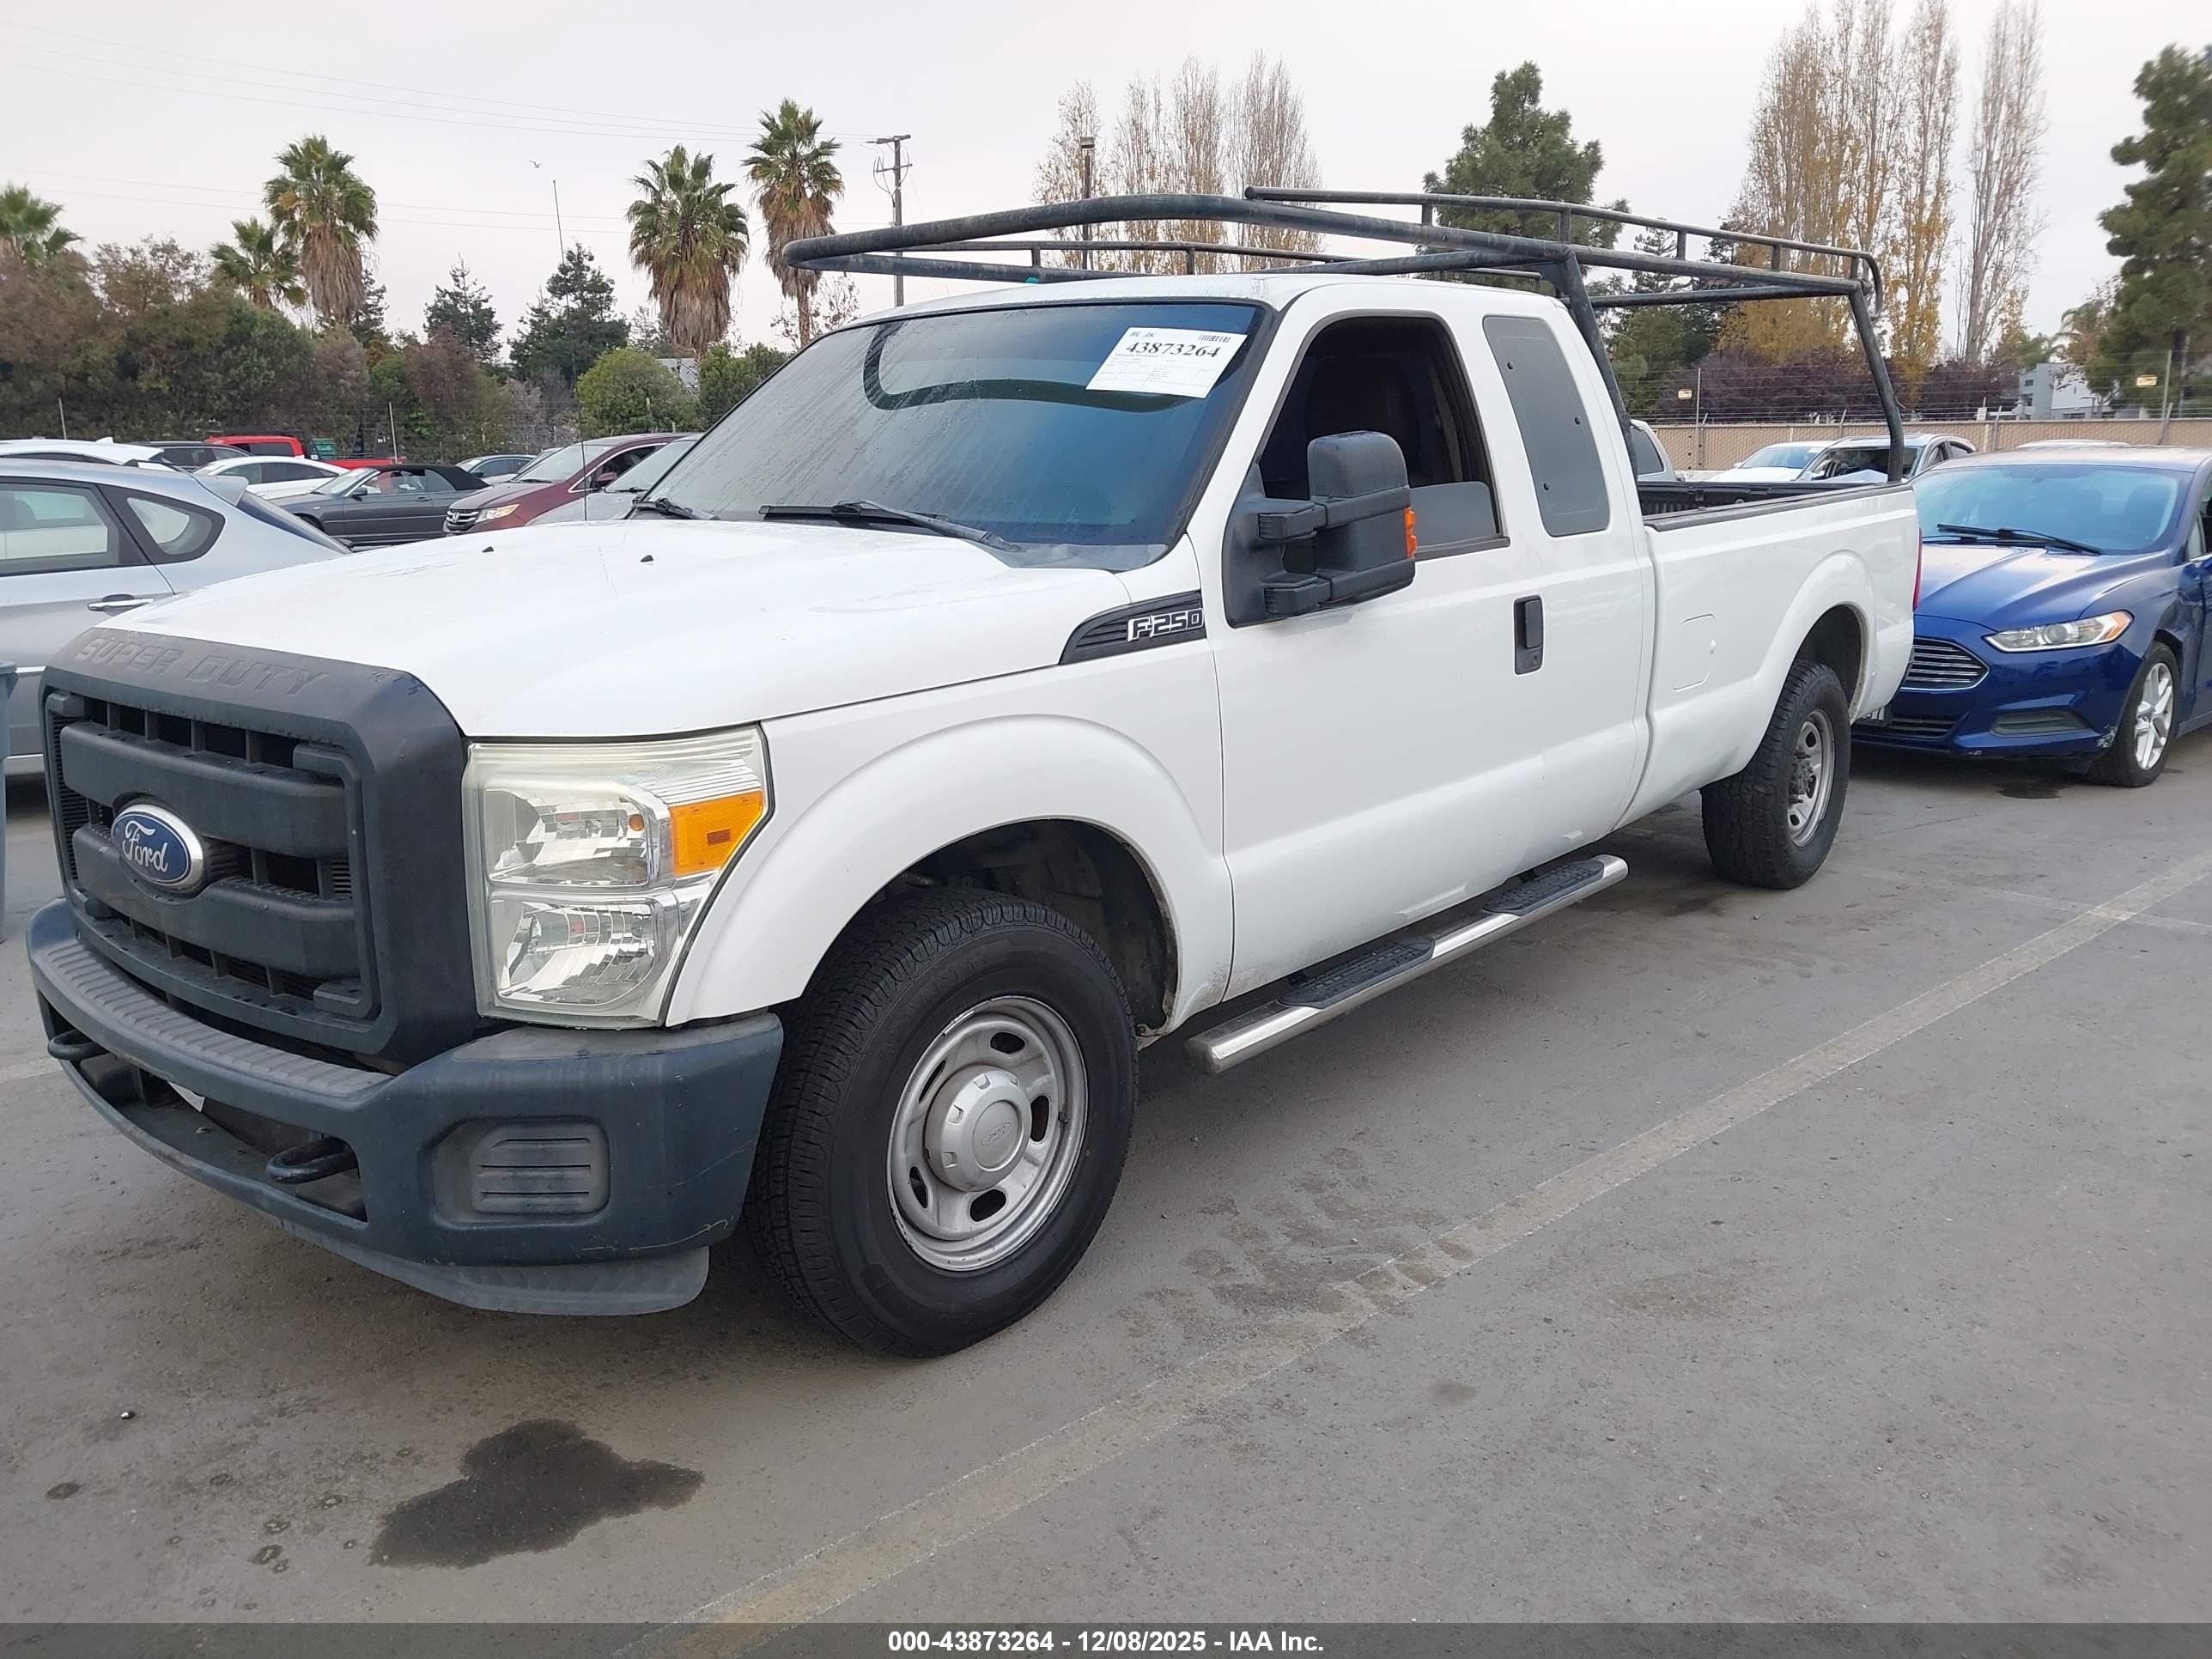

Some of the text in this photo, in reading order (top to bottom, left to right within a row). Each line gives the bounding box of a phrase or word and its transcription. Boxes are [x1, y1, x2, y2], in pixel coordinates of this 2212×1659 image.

[1126, 342, 1221, 357] 43873264
[1127, 607, 1204, 642] F-250
[76, 638, 330, 696] SUPER DUTY
[123, 820, 168, 872] Ford
